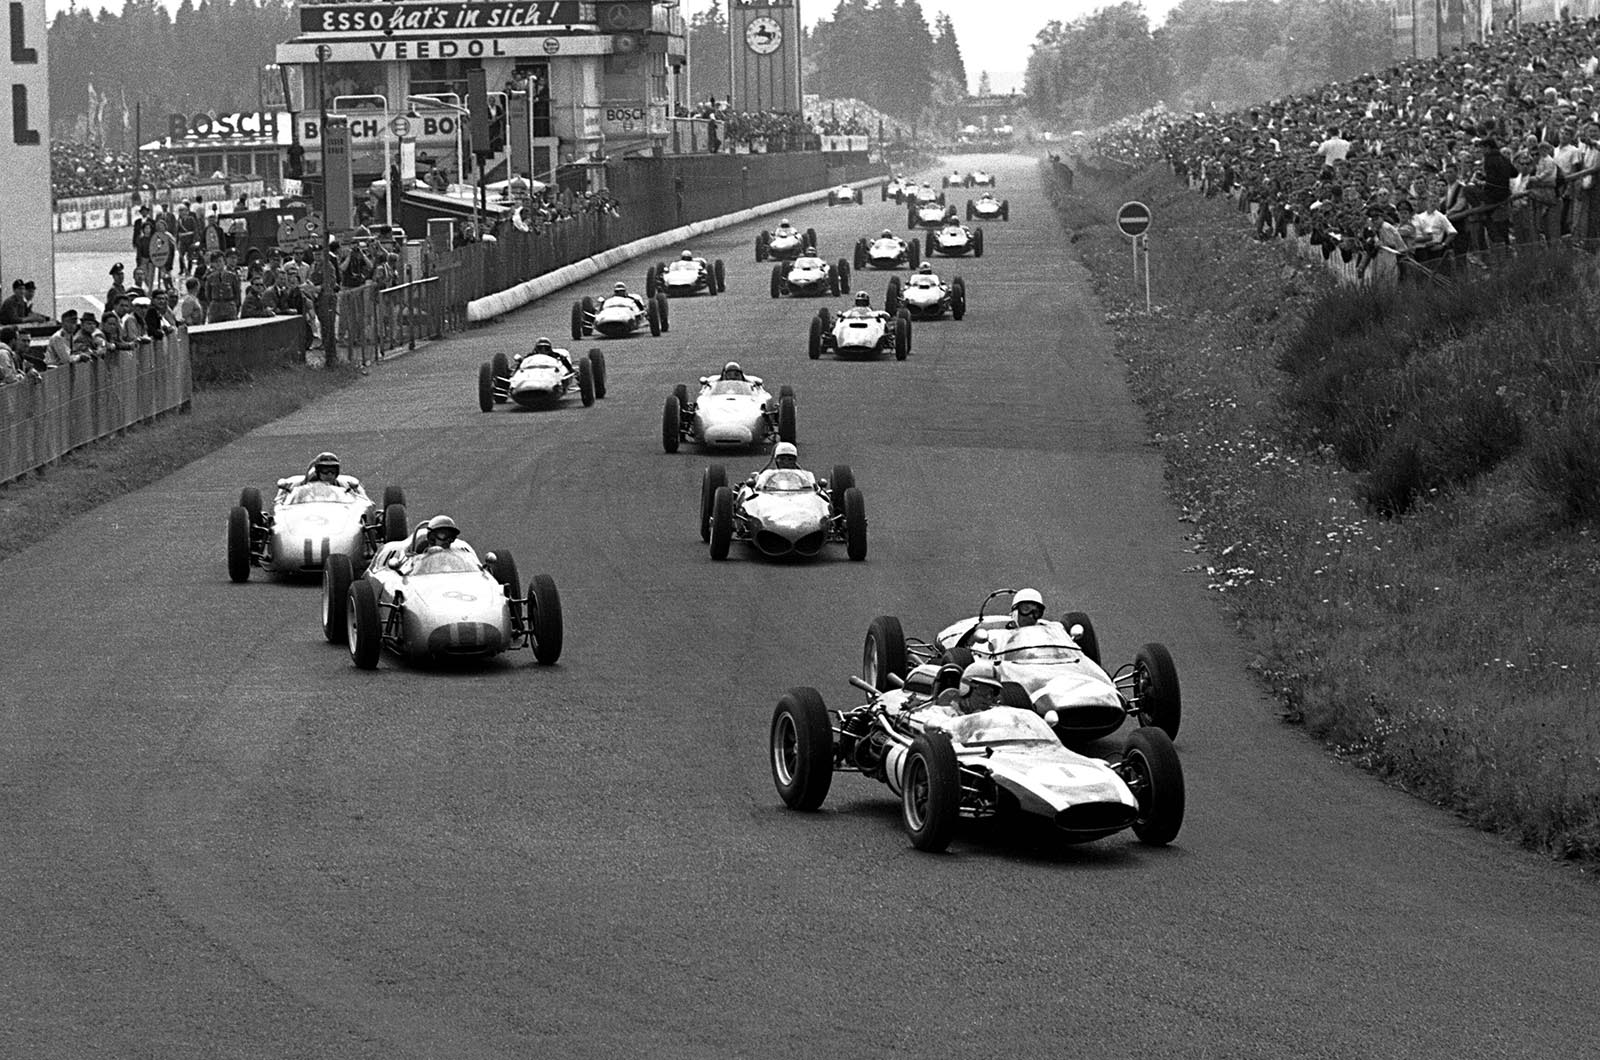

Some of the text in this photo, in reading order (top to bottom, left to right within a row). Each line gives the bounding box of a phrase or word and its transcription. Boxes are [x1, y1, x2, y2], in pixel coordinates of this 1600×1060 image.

[322, 10, 384, 30] ESSO
[388, 6, 448, 29] hat's
[456, 4, 479, 27] in
[370, 39, 506, 60] VEEDOL
[169, 112, 279, 142] BOSCH
[305, 119, 378, 139] BCH
